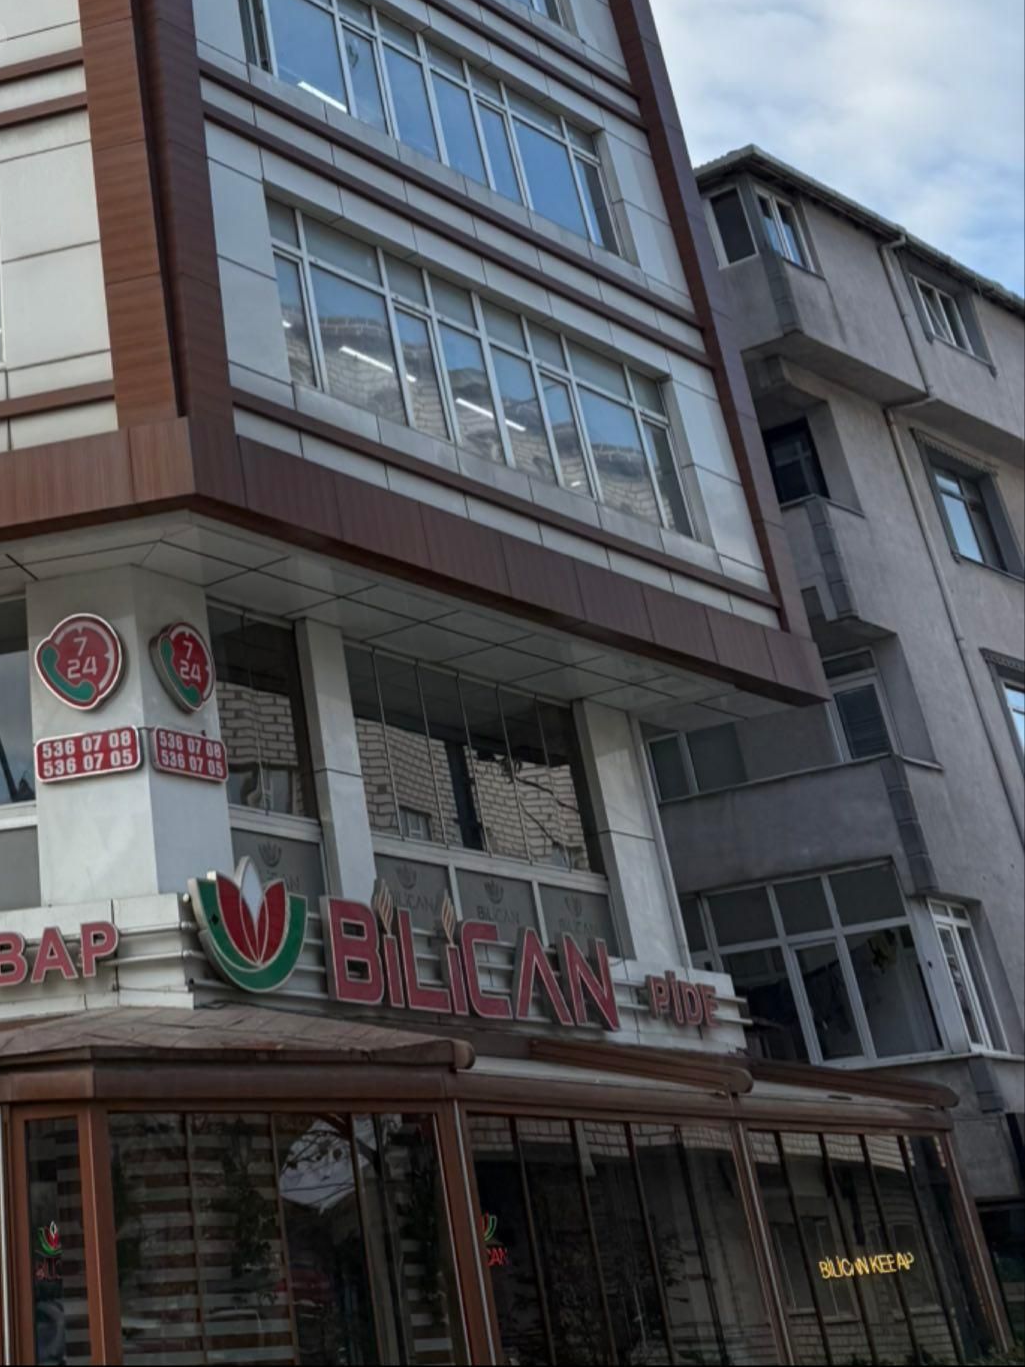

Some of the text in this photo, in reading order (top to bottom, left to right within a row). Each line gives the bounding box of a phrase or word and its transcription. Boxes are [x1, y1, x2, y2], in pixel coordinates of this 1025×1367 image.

[73, 636, 88, 657] 7
[183, 642, 194, 660] 7
[67, 656, 98, 679] 24
[179, 660, 202, 682] 24
[42, 730, 132, 759] 536 07 08
[158, 732, 222, 759] 536 07 08
[43, 748, 133, 778] 536 07 05
[161, 749, 224, 777] 536 07 05
